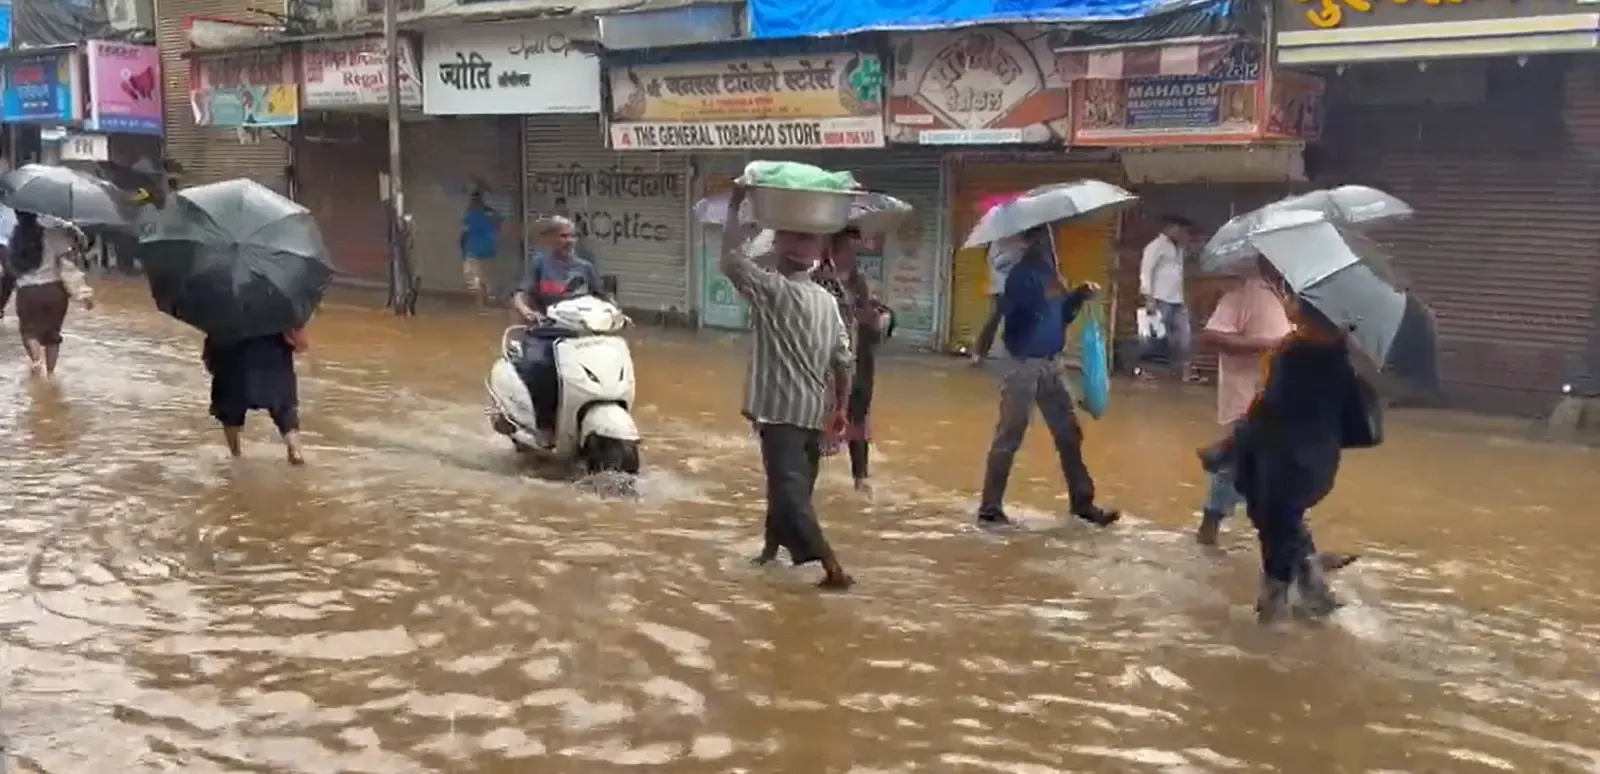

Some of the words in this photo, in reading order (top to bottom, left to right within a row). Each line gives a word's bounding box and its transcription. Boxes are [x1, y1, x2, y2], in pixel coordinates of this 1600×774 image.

[343, 70, 384, 88] Regal
[439, 51, 492, 90] ज्योति
[1128, 82, 1221, 99] MAHADEV
[634, 124, 657, 147] THE
[659, 124, 715, 146] GENERAL
[716, 123, 775, 146] TOBACCO
[777, 122, 822, 145] STORE
[592, 210, 669, 245] Optics
